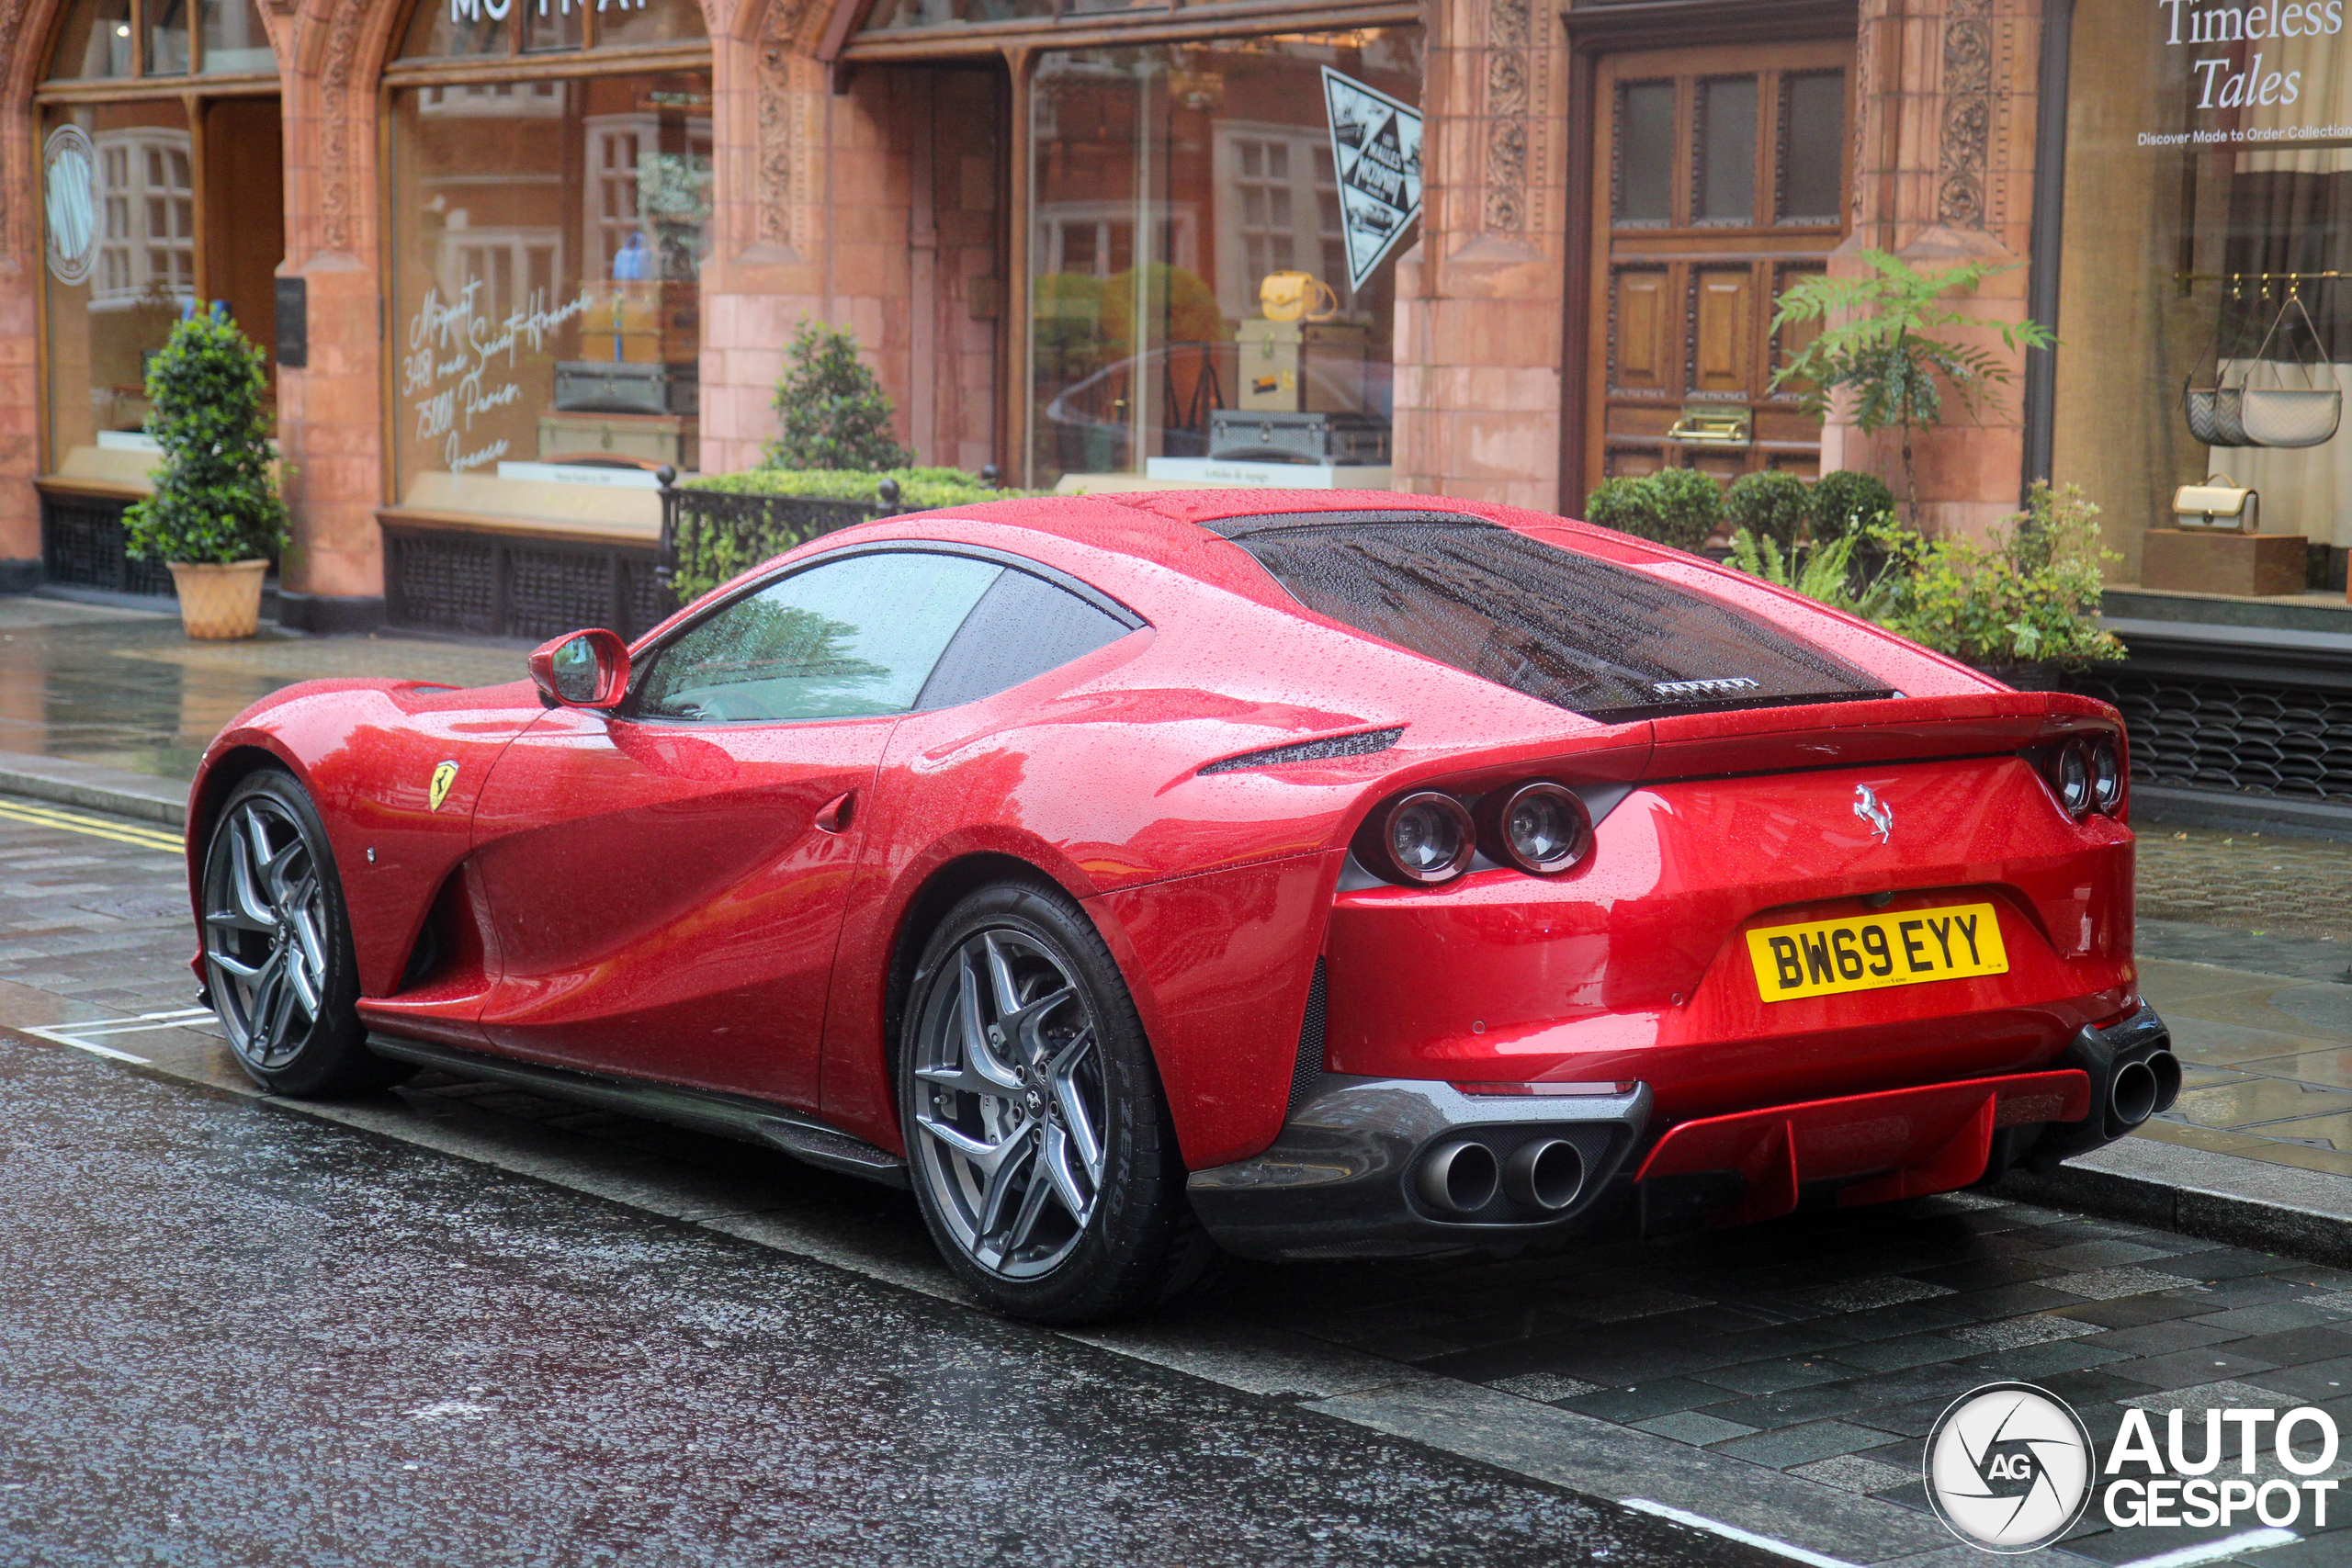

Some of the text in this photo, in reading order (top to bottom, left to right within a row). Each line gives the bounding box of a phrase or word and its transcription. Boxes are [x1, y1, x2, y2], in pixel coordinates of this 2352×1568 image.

[2159, 0, 2343, 45] Timeless
[2193, 52, 2301, 109] Tales
[2138, 130, 2190, 145] Discover
[2193, 128, 2227, 143] Made
[2230, 129, 2244, 141] to
[2247, 125, 2285, 141] Order
[1768, 914, 1980, 989] BW69 EYY
